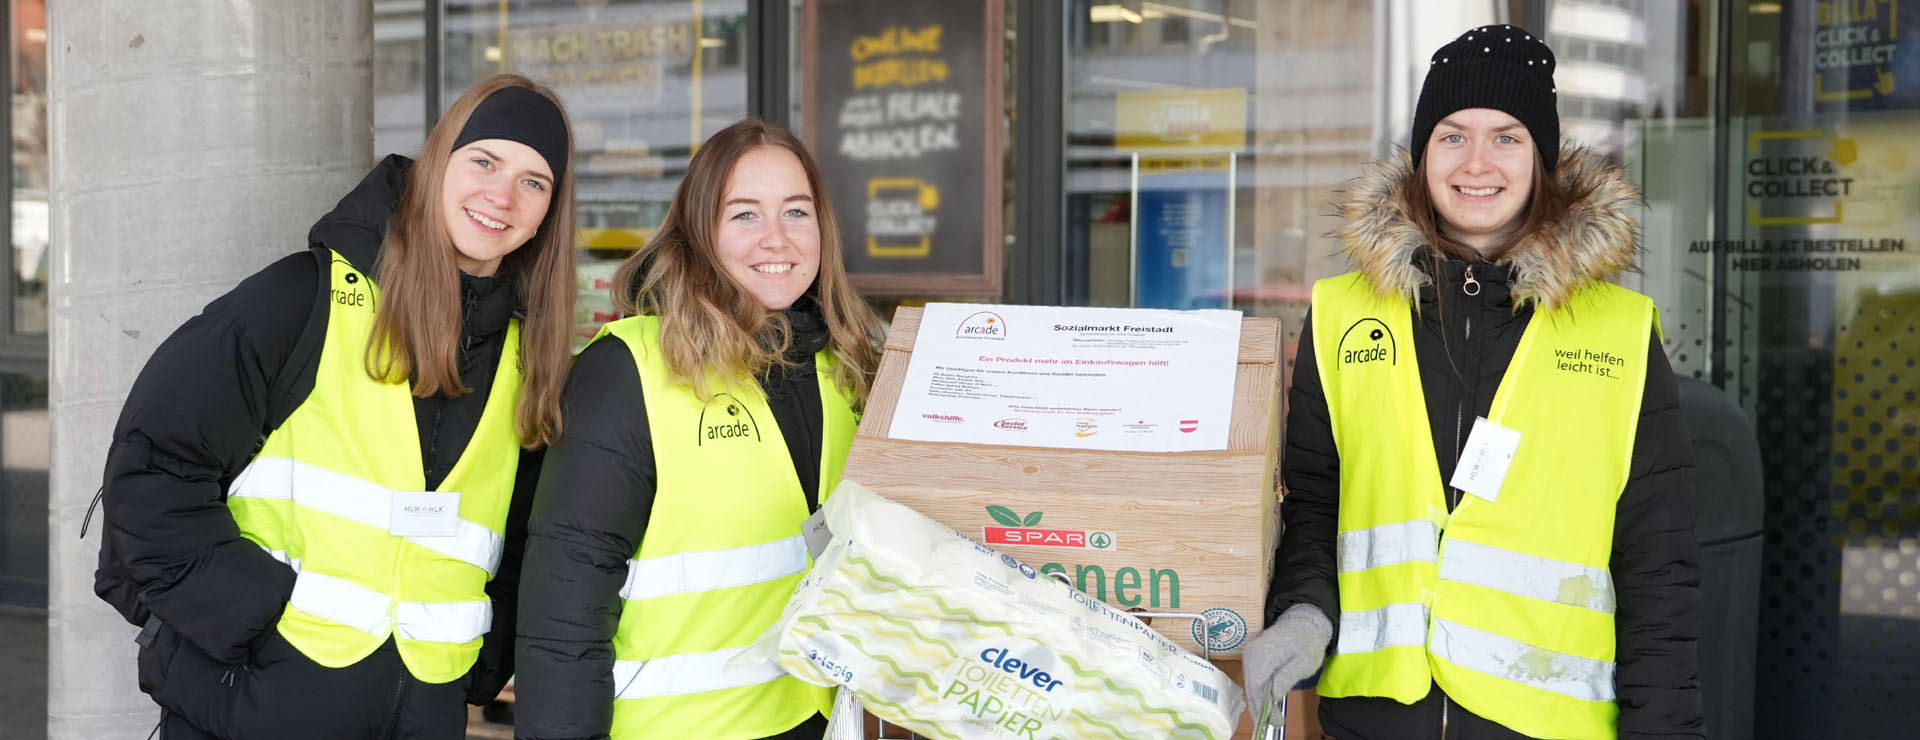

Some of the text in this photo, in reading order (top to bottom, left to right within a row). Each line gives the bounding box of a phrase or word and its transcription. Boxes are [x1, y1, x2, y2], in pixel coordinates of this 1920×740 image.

[1817, 0, 1878, 26] BILLA
[1815, 28, 1880, 47] CLICK &
[1815, 45, 1896, 69] COLLECT
[1748, 158, 1833, 176] CLICK &
[1748, 178, 1853, 197] COLLECT
[1803, 238, 1904, 253] BESTELLEN
[1732, 257, 1860, 272] HIER ABHOLEN
[331, 287, 364, 307] rcade
[964, 324, 999, 335] arcade
[1053, 324, 1174, 334] Sozialmarkt Freistadt
[978, 355, 994, 363] Ein
[996, 356, 1032, 364] Produkt
[1035, 357, 1059, 365] mehr
[1061, 358, 1073, 366] im
[1075, 358, 1146, 368] Einkaufswagen
[1344, 343, 1387, 364] arcade
[1555, 349, 1624, 367] weil helfen
[1557, 359, 1593, 374] leicht
[707, 420, 750, 440] arcade
[404, 505, 444, 513] HLW HLK
[1005, 531, 1084, 545] SPAR
[980, 647, 1064, 693] clever
